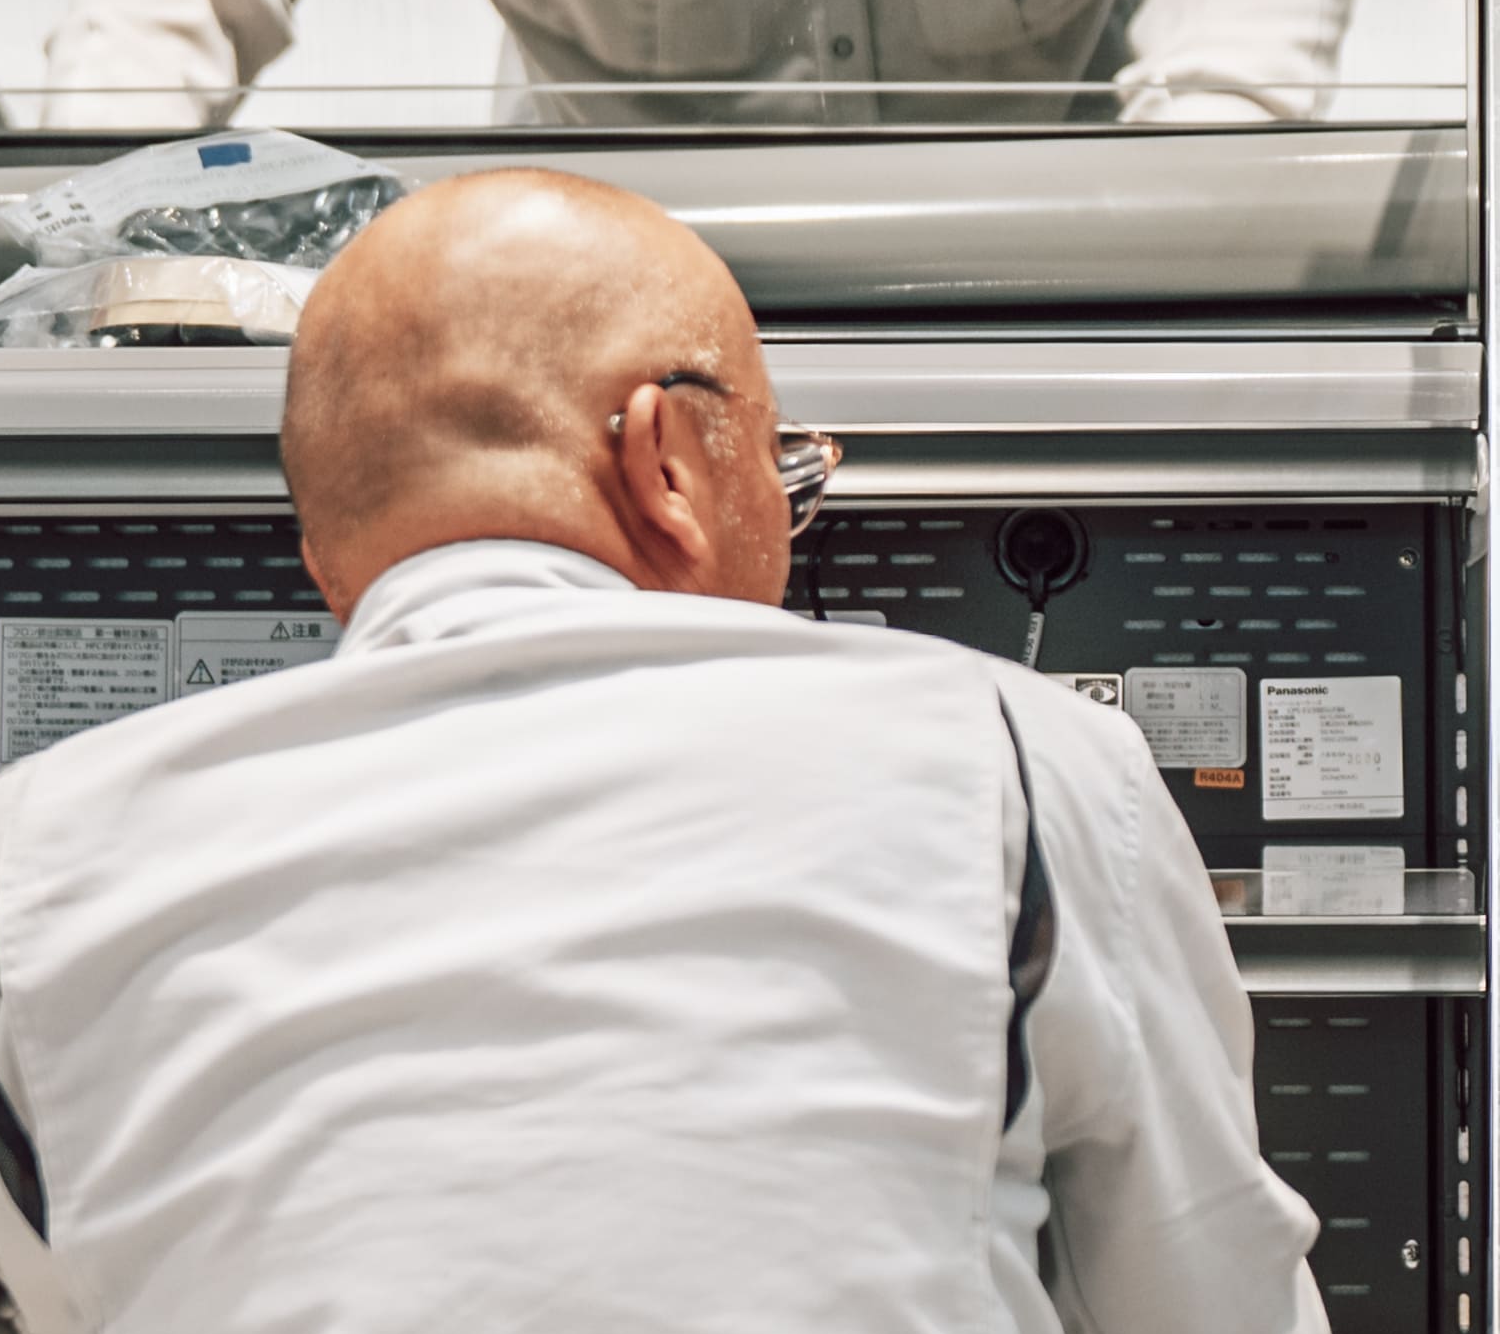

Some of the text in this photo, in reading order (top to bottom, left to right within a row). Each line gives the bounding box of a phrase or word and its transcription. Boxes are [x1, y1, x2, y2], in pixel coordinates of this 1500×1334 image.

[292, 622, 322, 638] 注意
[1267, 685, 1329, 696] Panasonic
[1200, 770, 1241, 783] R404A
